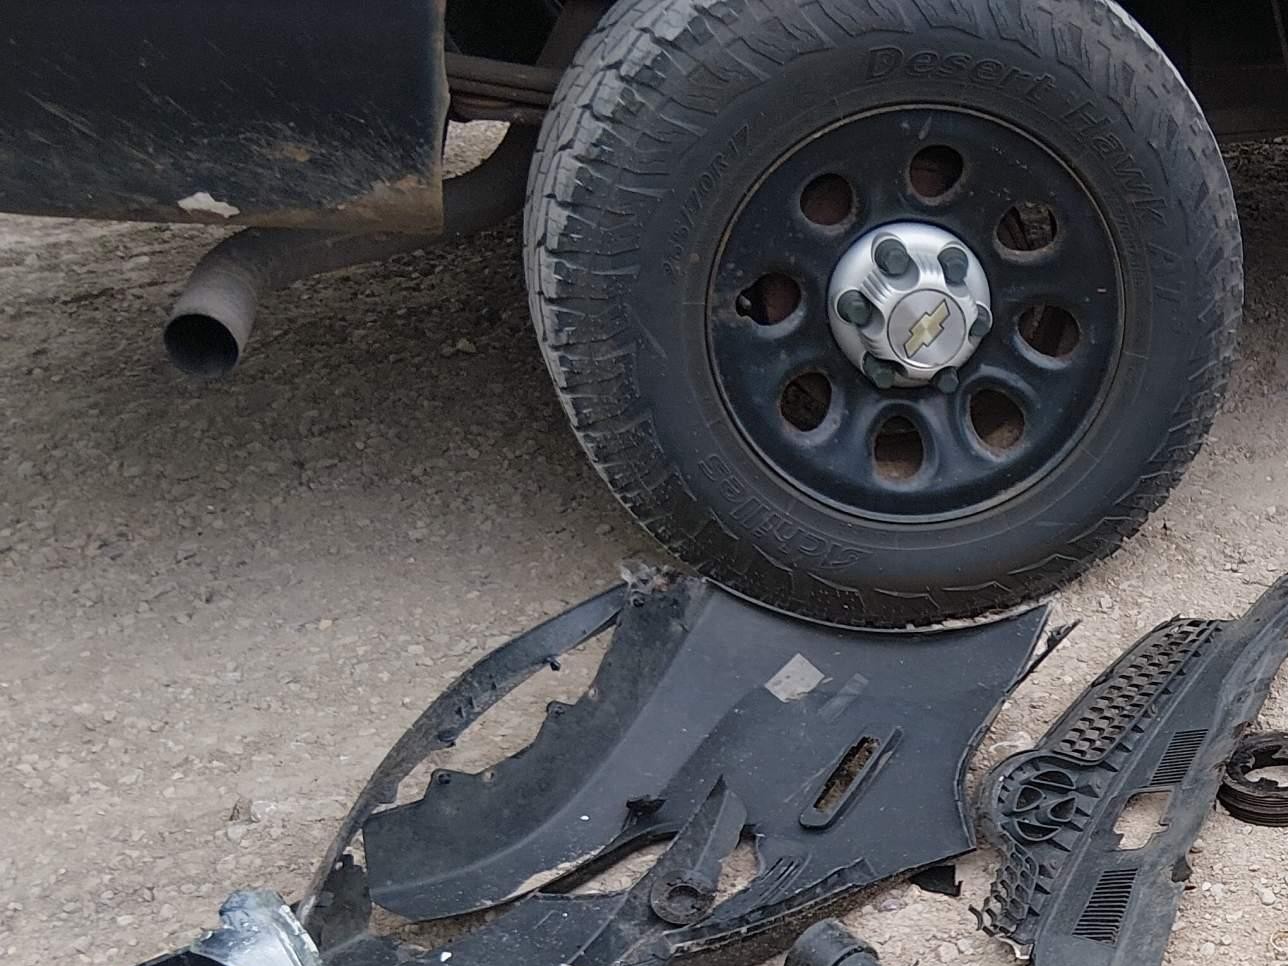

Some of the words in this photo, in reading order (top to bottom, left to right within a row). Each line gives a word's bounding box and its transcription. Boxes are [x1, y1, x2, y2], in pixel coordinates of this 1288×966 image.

[857, 44, 1056, 104] Desert
[1061, 99, 1167, 226] Hawk
[698, 453, 874, 570] Achilles
